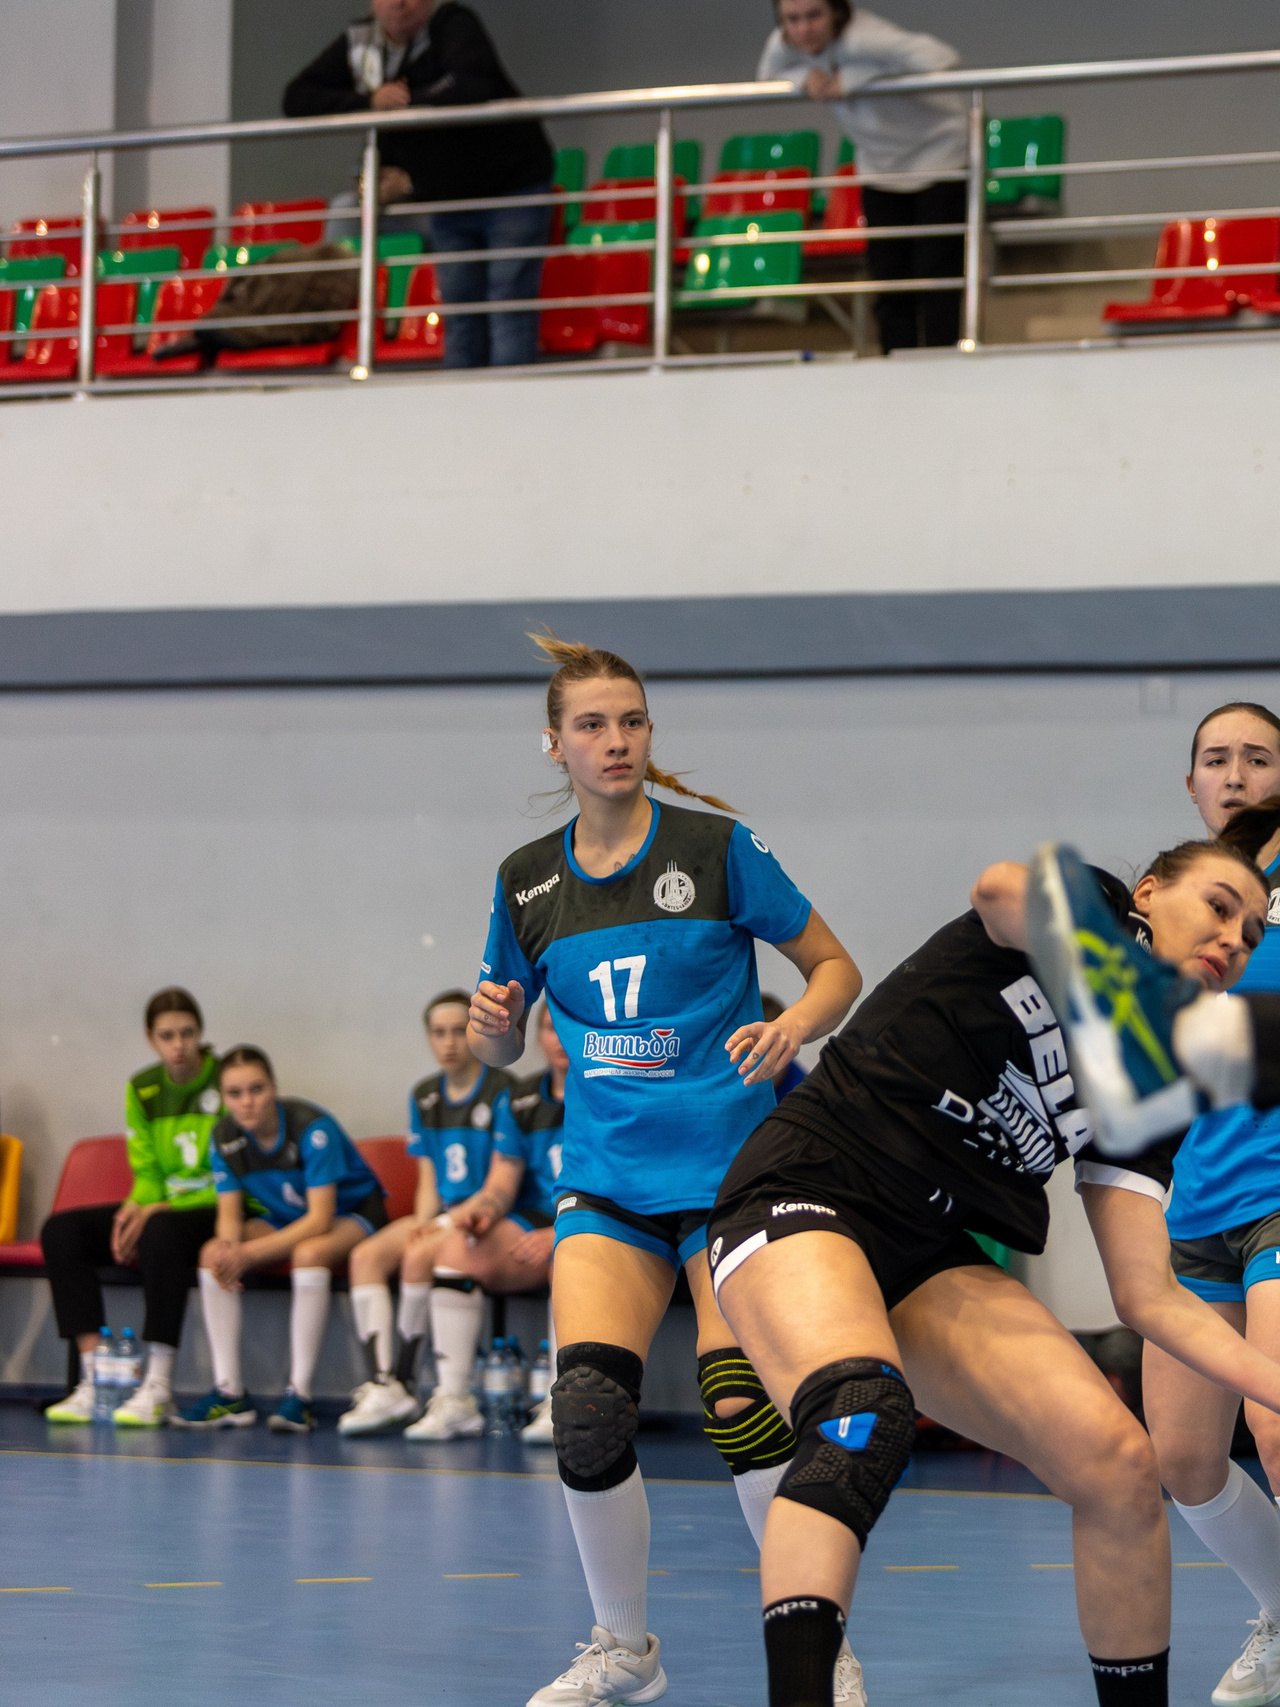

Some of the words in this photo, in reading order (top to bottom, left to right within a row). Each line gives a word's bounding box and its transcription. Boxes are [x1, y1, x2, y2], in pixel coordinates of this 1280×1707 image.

[515, 873, 560, 905] Kempa
[588, 954, 647, 1022] 17
[583, 1028, 681, 1058] Витьба
[1000, 974, 1095, 1157] BELA
[771, 1202, 837, 1217] Kempa
[764, 1600, 819, 1619] mpa
[1092, 1662, 1154, 1677] empa
